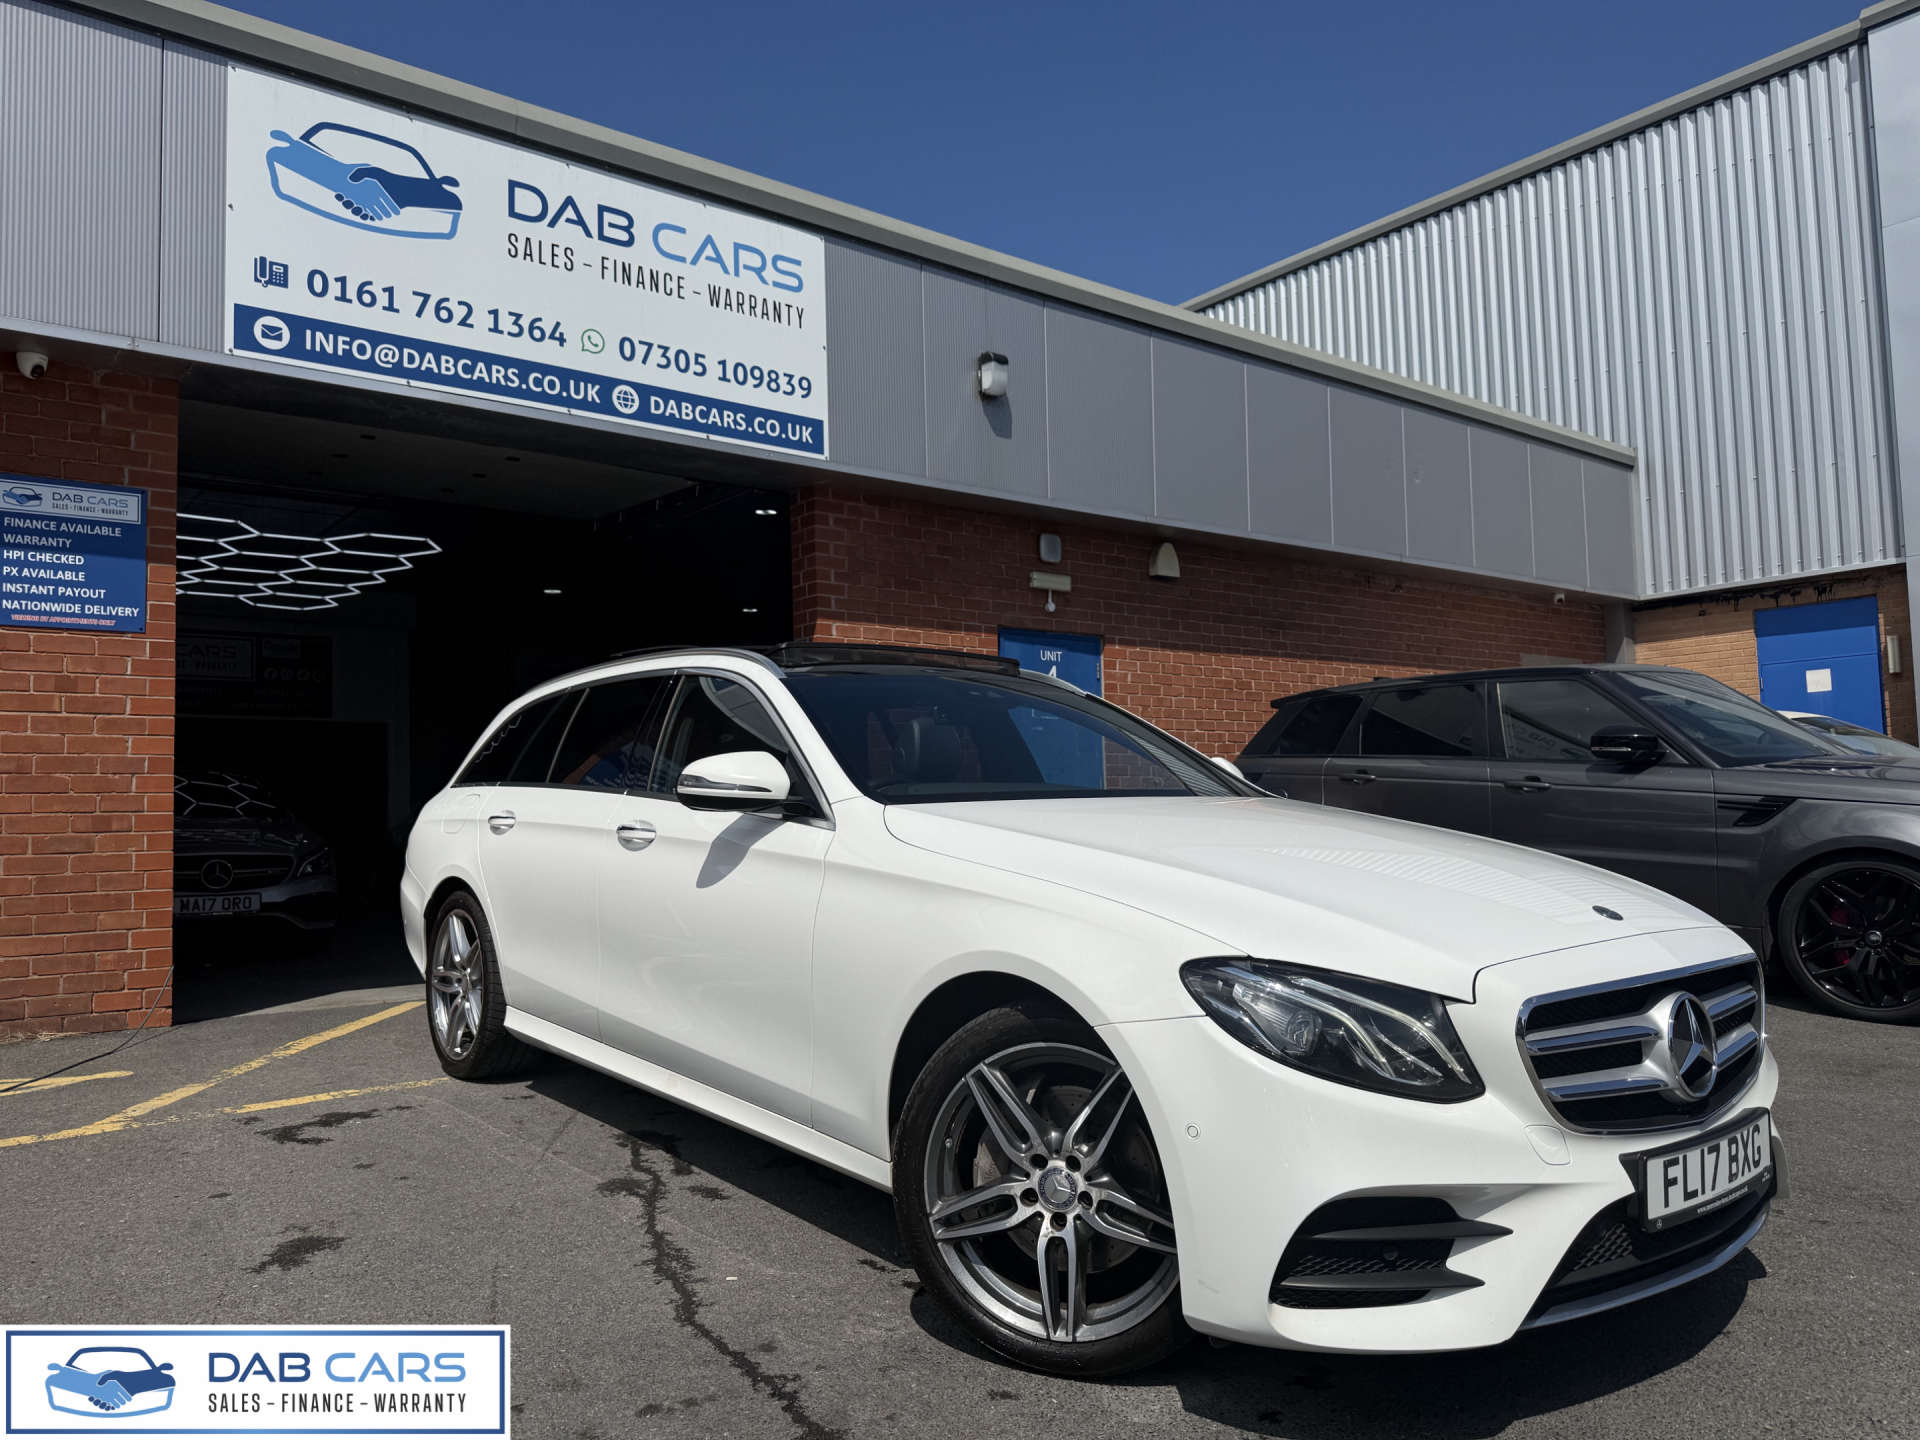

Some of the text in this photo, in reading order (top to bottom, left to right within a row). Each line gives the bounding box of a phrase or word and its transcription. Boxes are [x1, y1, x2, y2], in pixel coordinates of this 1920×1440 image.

[507, 179, 804, 293] DAB CARS
[507, 233, 575, 271] SALES
[600, 256, 686, 300] FINANCE
[707, 283, 805, 329] WARRANTY
[306, 268, 567, 348] 0161 762 1364
[304, 328, 601, 404] INFO@DABCARS.CO.UK
[618, 335, 812, 399] 07305 109839
[649, 395, 814, 444] DABCARS.CO.UK
[52, 491, 129, 509] DAB CARS
[4, 516, 122, 537] FINANCE AVAILABLE
[3, 533, 72, 548] WARRANTY
[3, 549, 85, 565] HPI CHECKED
[3, 566, 86, 581] PX AVAILABLE
[2, 582, 106, 599] INSTANT PAYOUT
[2, 599, 140, 617] NATIONWIDE DELIVERY
[1040, 649, 1063, 663] UNIT
[1663, 1142, 1721, 1209] FL17
[1727, 1123, 1762, 1184] BXG
